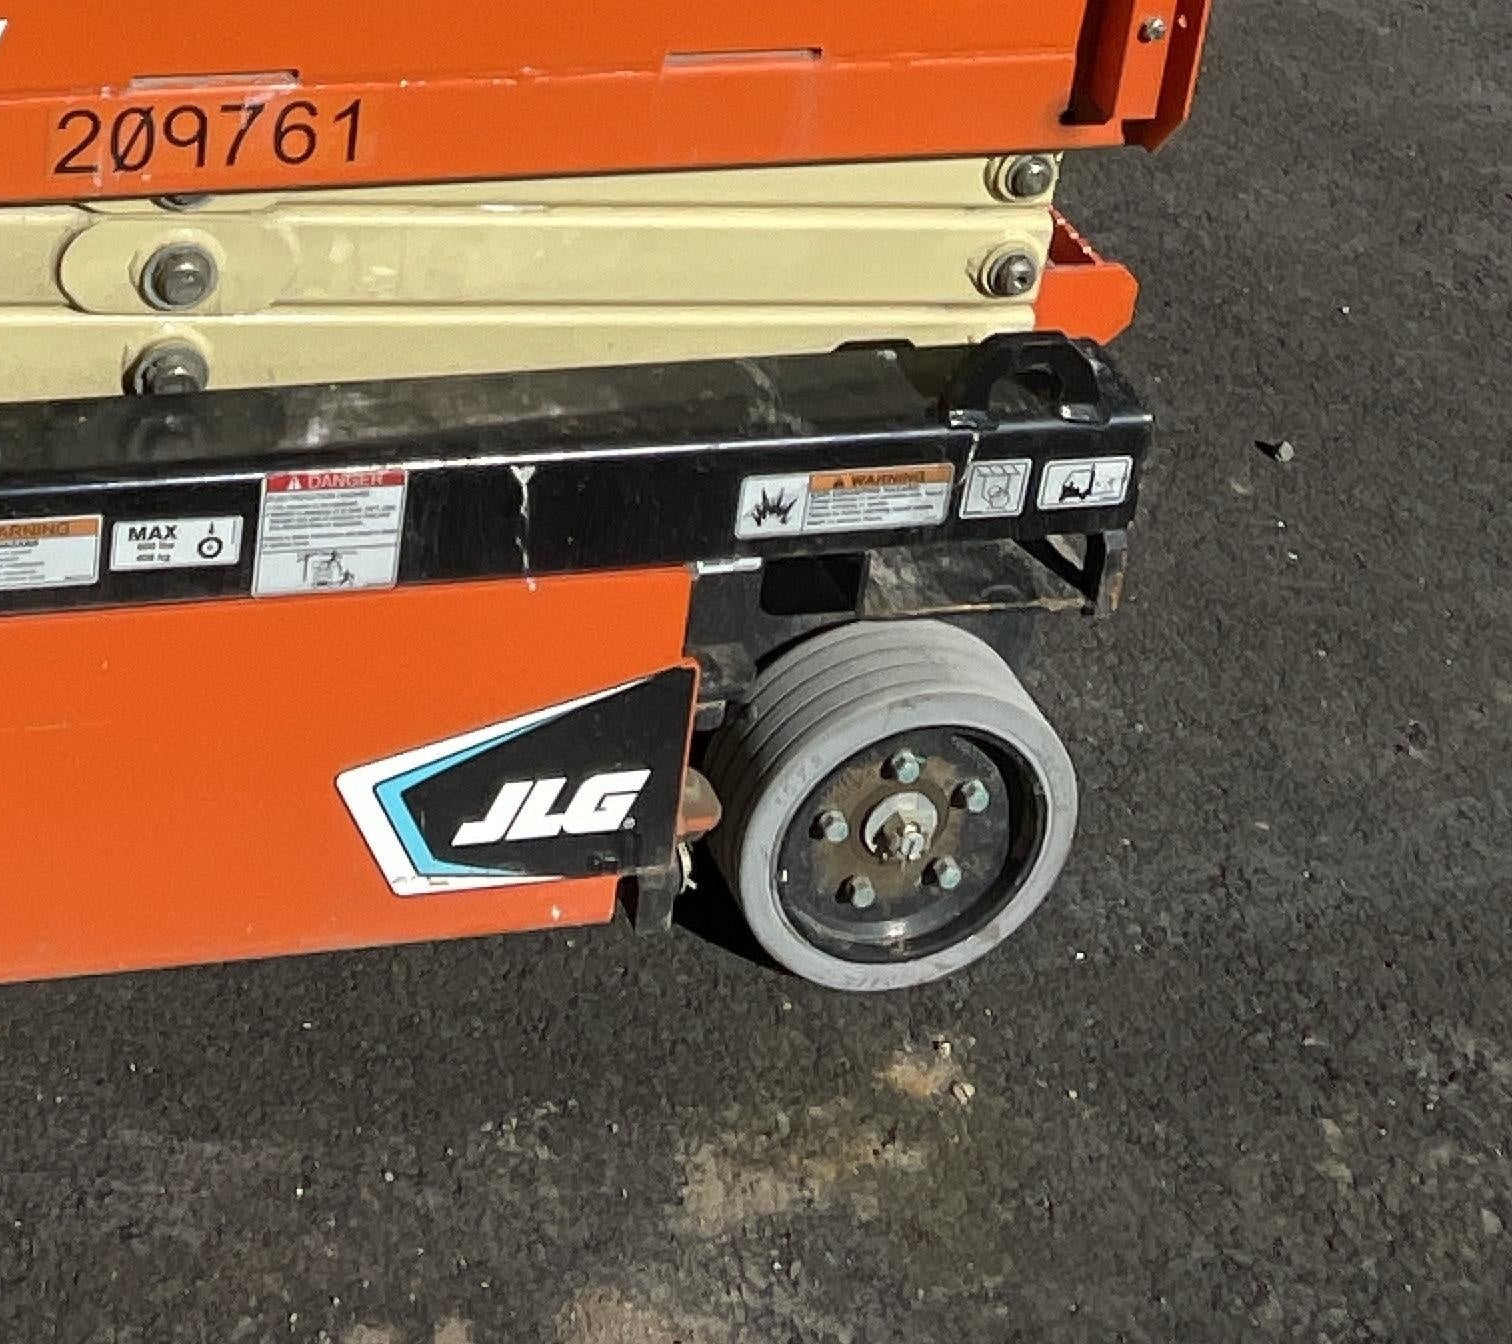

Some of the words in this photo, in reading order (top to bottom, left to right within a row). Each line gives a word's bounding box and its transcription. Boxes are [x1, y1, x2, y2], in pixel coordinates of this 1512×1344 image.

[308, 473, 384, 488] DANGER
[128, 524, 178, 541] MAX
[450, 769, 651, 847] JLG
